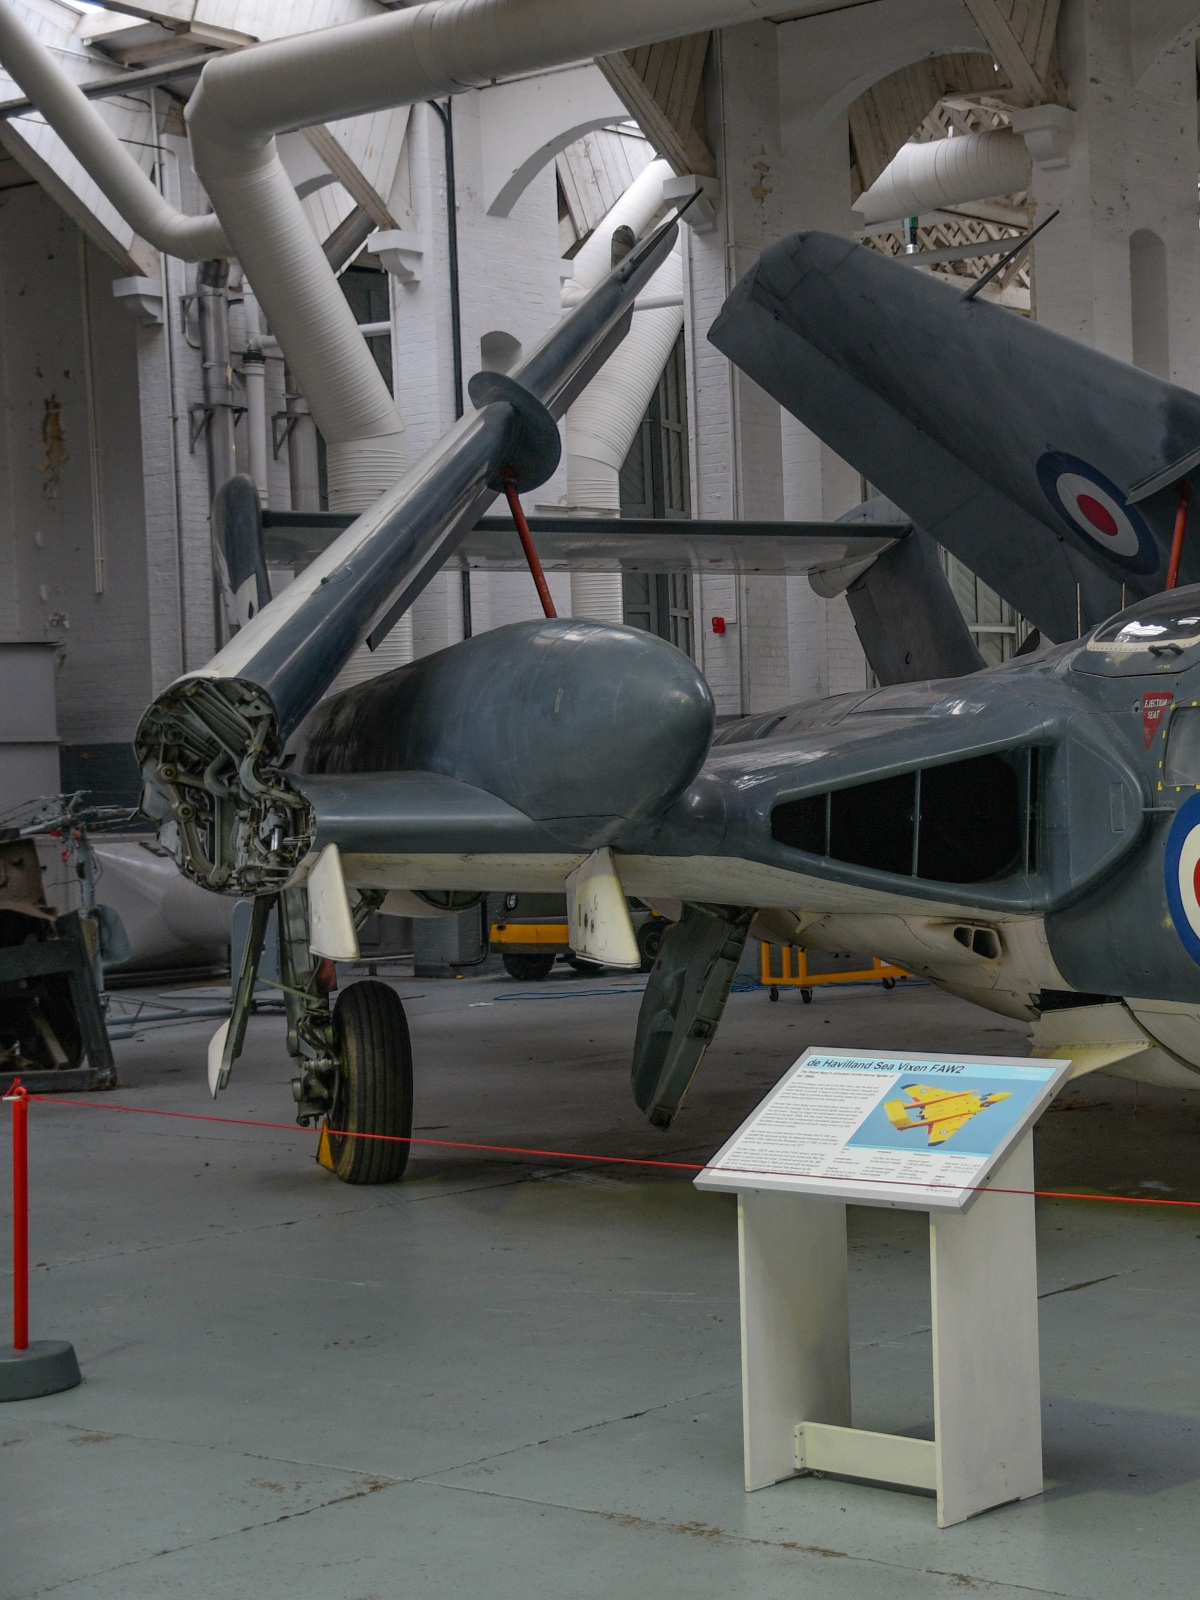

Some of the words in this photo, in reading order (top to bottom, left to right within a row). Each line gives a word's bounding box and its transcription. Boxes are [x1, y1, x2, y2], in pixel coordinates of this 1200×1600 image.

[1144, 698, 1168, 708] EJECTION
[1147, 710, 1160, 719] SEAT
[807, 1058, 821, 1067] de
[822, 1059, 873, 1070] Havilland
[873, 1061, 895, 1071] Sea
[898, 1062, 928, 1073] Vixen
[929, 1064, 966, 1074] FAW2
